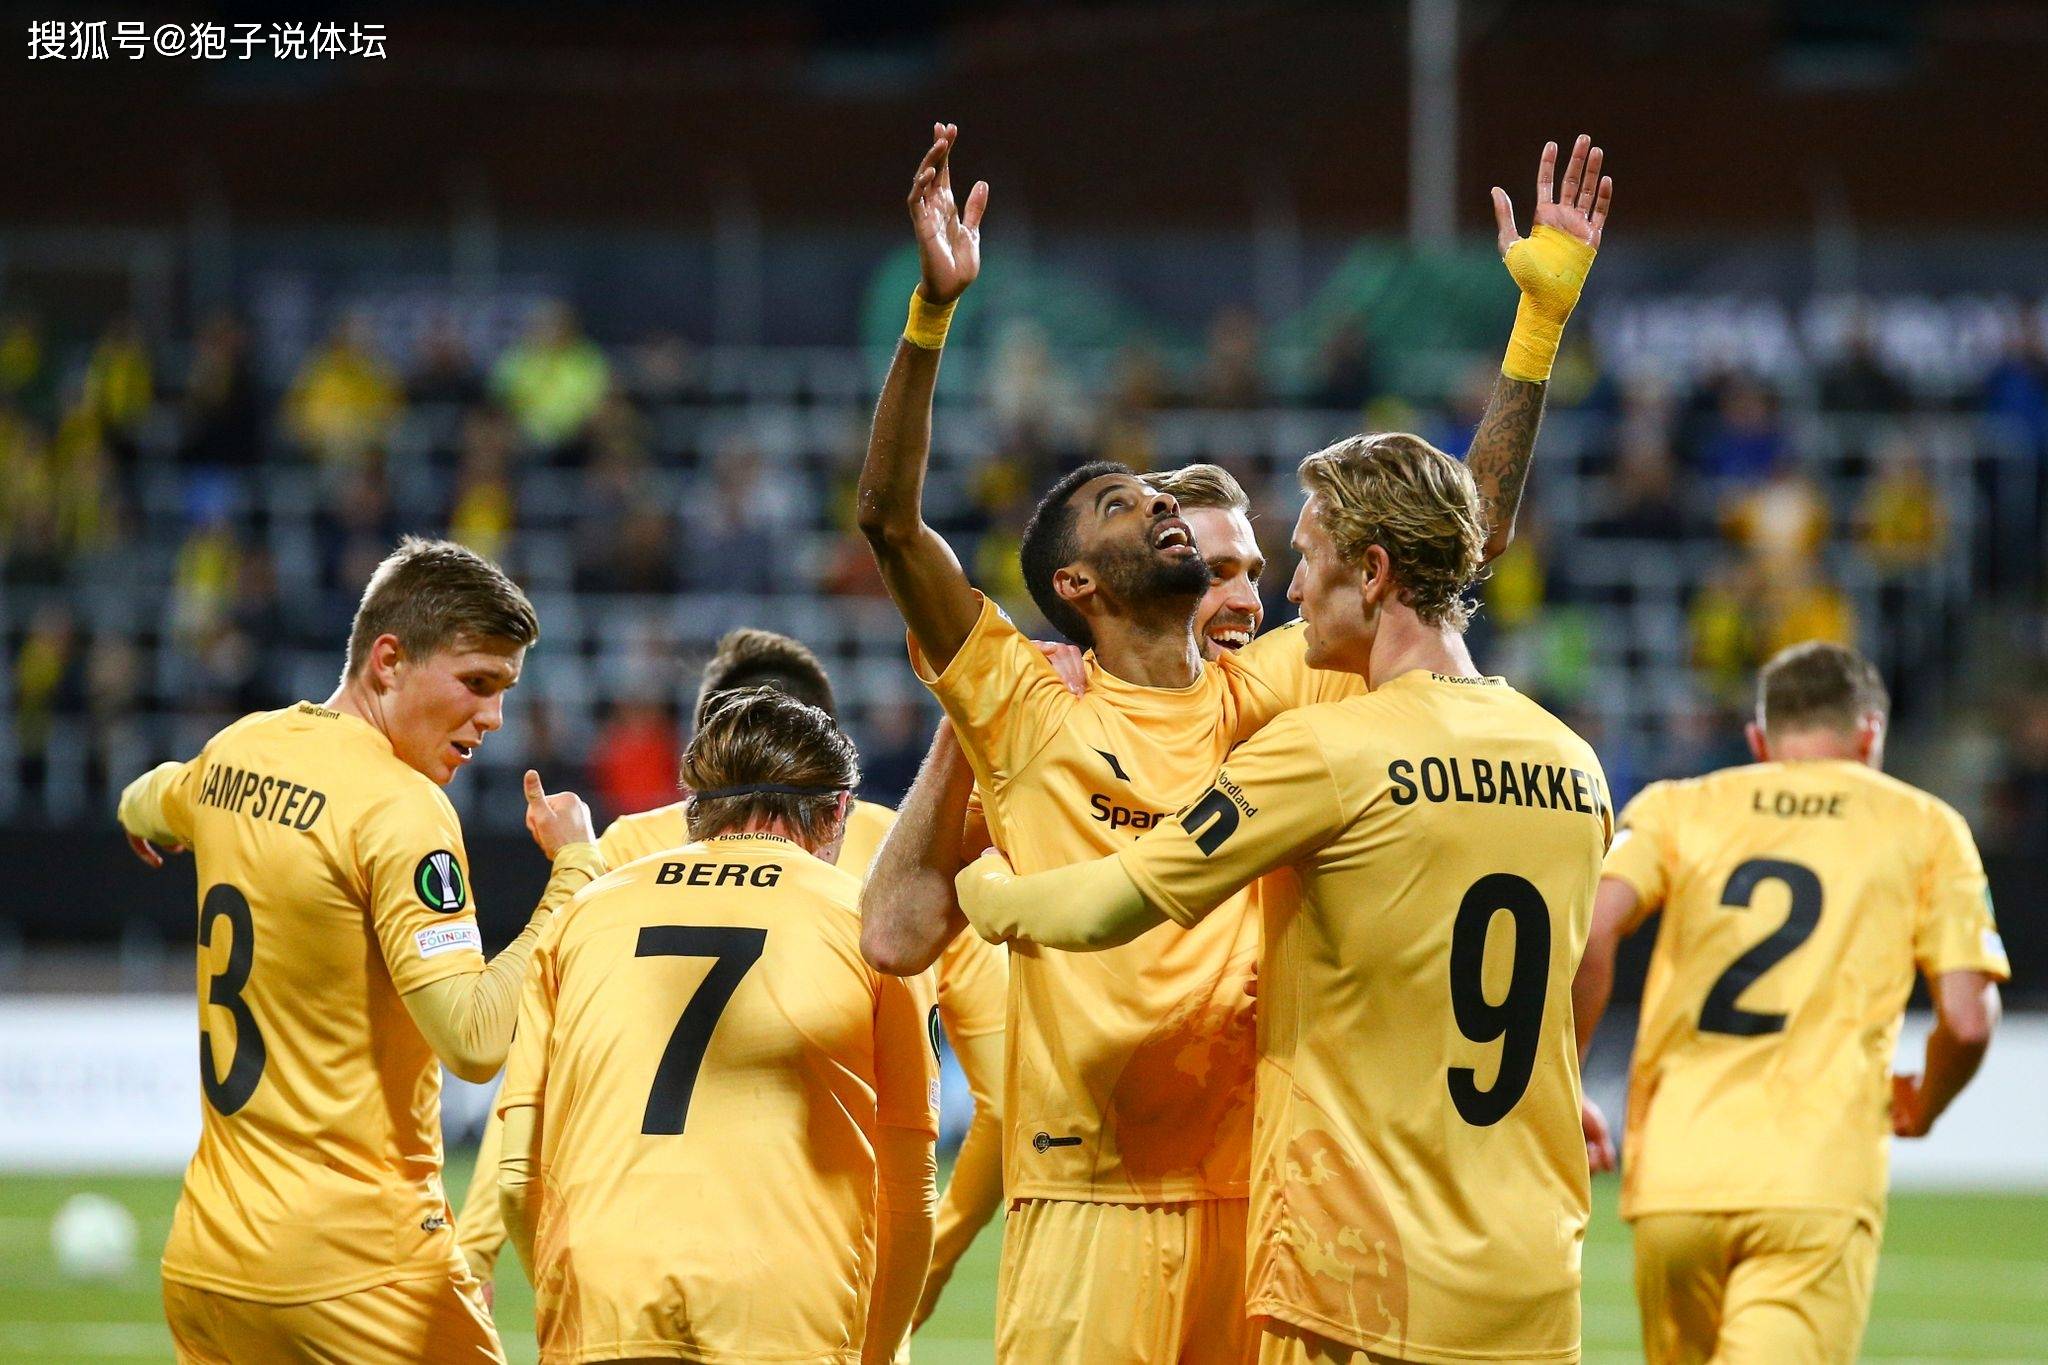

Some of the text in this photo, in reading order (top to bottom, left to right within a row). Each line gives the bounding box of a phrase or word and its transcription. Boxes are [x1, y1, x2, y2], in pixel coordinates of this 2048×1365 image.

[655, 862, 783, 888] BERG
[1090, 793, 1175, 830] Spar
[199, 882, 266, 1117] 3
[634, 925, 768, 1135] 7
[1447, 873, 1551, 1127] 9
[1698, 859, 1823, 1036] 2
